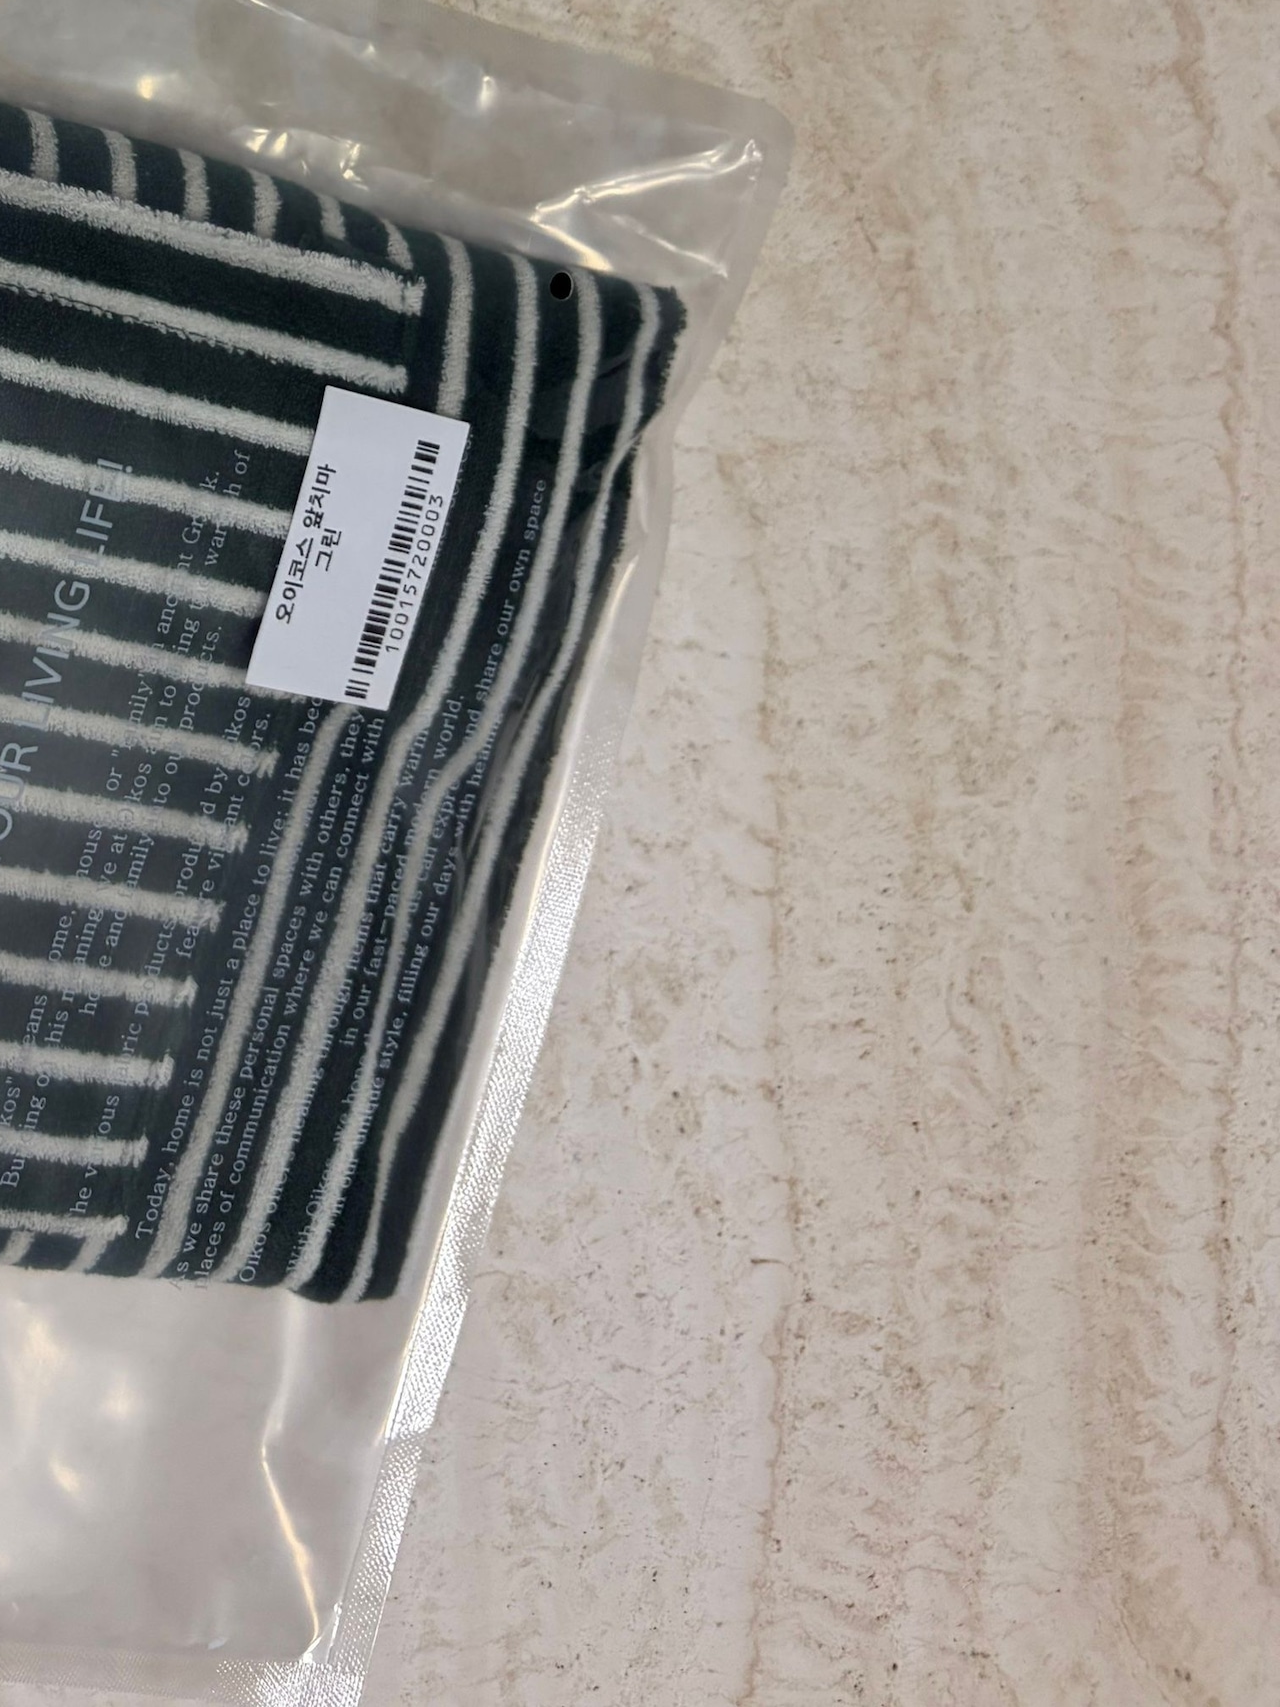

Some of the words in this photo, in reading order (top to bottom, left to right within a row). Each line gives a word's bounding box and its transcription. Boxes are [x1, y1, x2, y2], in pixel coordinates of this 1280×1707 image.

[518, 477, 549, 541] space
[272, 533, 318, 625] 오이코스
[298, 460, 339, 531] 앞치마
[311, 525, 342, 572] 그린
[505, 546, 533, 594] own
[17, 578, 92, 731] LIVING
[70, 457, 134, 564] LIFE!
[384, 493, 445, 655] 10015720003
[494, 598, 518, 637] our
[113, 831, 129, 856] at
[156, 683, 178, 709] to
[231, 448, 252, 476] of
[474, 641, 505, 703] share
[434, 694, 466, 761] world.
[103, 765, 124, 793] or
[203, 767, 229, 795] by
[283, 739, 311, 781] has
[276, 785, 297, 804] it
[405, 766, 441, 849] modern
[453, 790, 477, 840] with
[250, 862, 272, 888] to
[429, 844, 458, 896] days
[230, 891, 259, 953] place
[359, 852, 411, 977] fast-paced
[419, 901, 441, 938] our
[181, 1219, 203, 1255] we
[194, 1151, 226, 1216] share
[211, 1084, 247, 1147] these
[239, 983, 277, 1081] personal
[269, 901, 303, 979] spaces
[299, 848, 325, 898] with
[314, 766, 352, 845] others,
[335, 709, 367, 758] they
[217, 1188, 236, 1215] of
[229, 1021, 292, 1187] communication
[285, 947, 317, 1018] where
[307, 908, 329, 943] we
[319, 864, 343, 904] can
[335, 770, 373, 860] connect
[361, 714, 387, 766] with
[224, 955, 241, 971] a
[394, 942, 431, 1004] filling
[204, 975, 231, 1021] just
[349, 983, 374, 1022] our
[199, 1023, 219, 1063] not
[237, 1219, 274, 1285] Oikos
[361, 859, 389, 904] that
[376, 795, 409, 854] carry
[337, 1025, 359, 1048] in
[379, 1010, 407, 1069] style,
[182, 1066, 205, 1088] is
[160, 1092, 197, 1156] home
[133, 1160, 175, 1242] Today,
